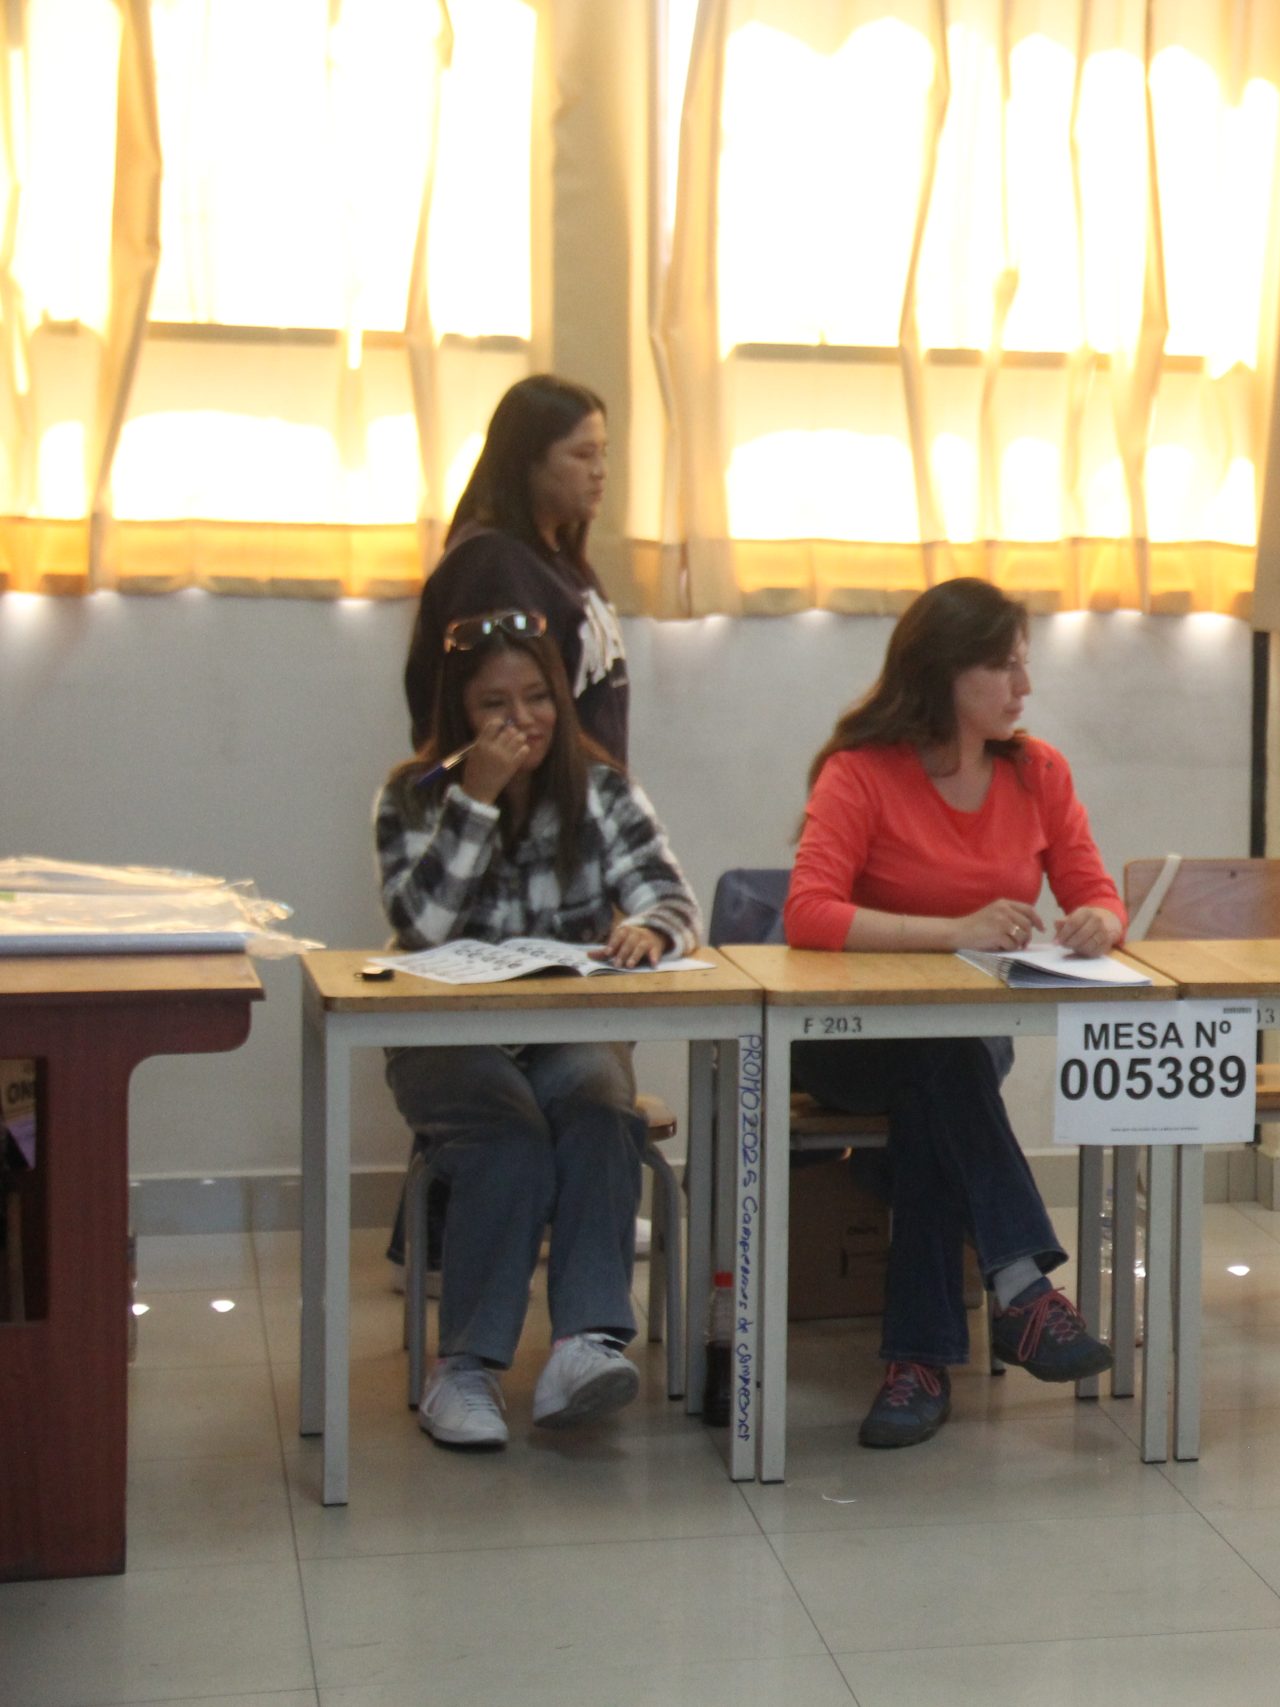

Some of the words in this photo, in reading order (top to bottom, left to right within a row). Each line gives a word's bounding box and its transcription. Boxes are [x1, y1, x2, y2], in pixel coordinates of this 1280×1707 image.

[803, 1017, 815, 1034] F
[823, 1015, 863, 1034] 203
[1084, 1021, 1185, 1051] MESA
[1060, 1055, 1247, 1101] 005389
